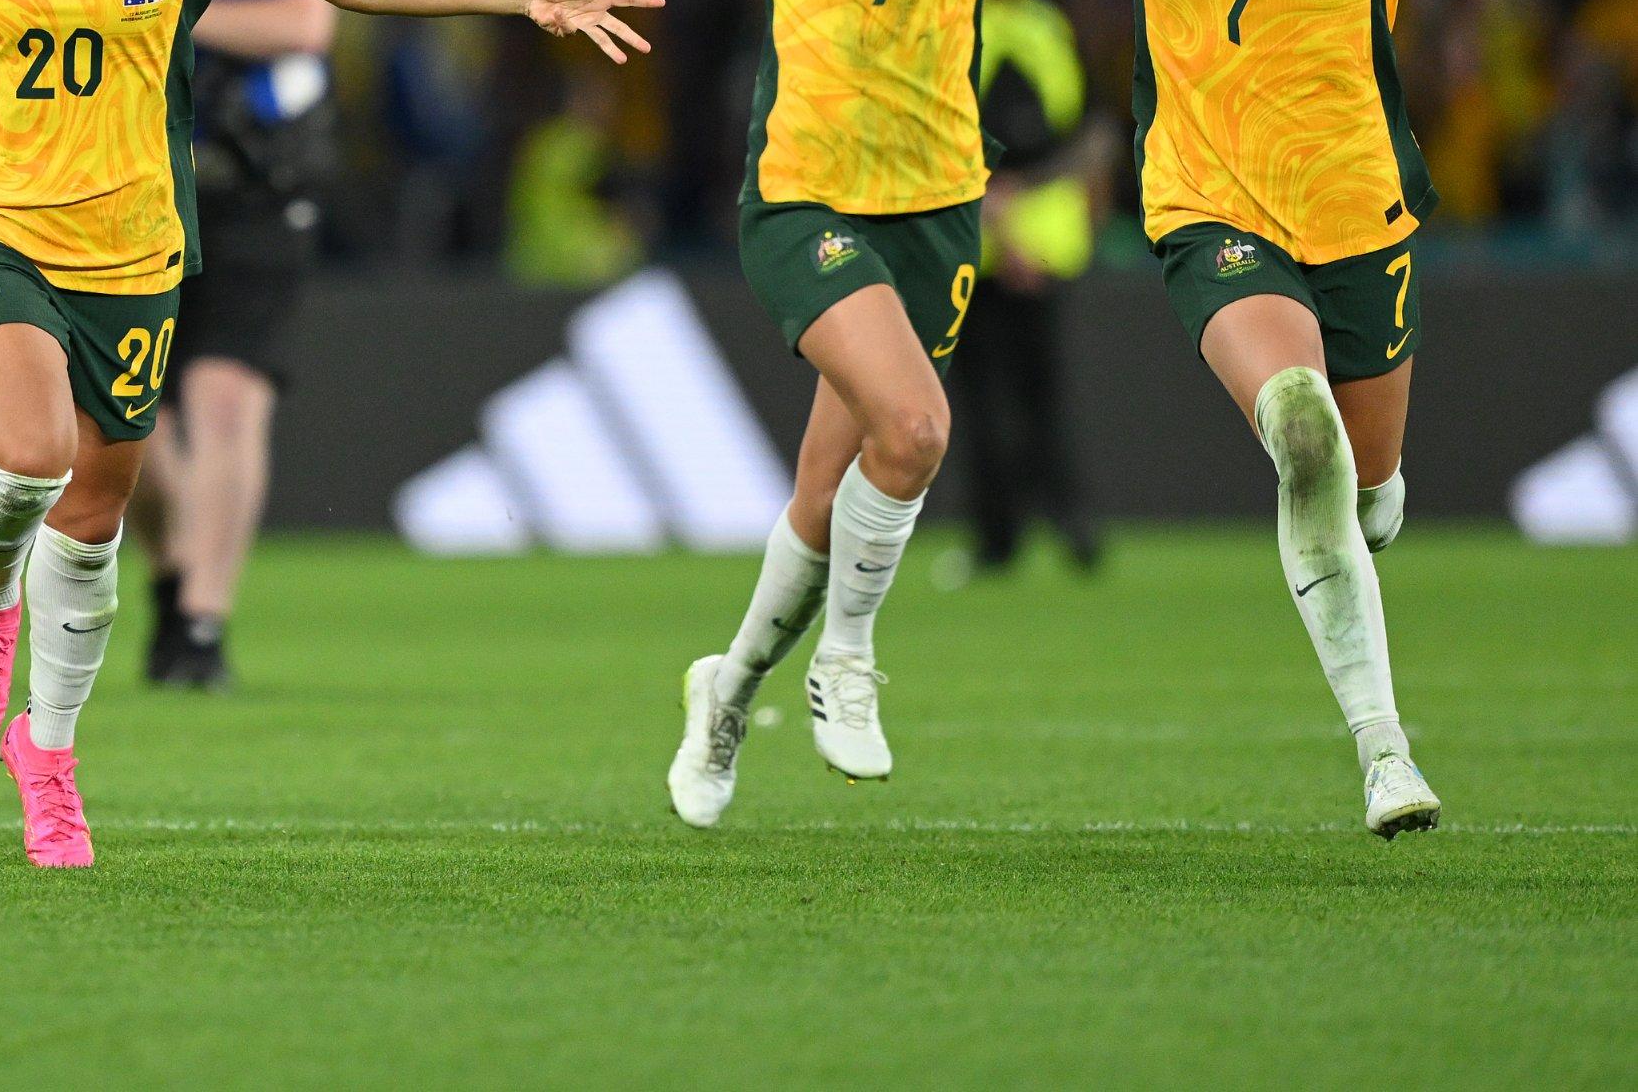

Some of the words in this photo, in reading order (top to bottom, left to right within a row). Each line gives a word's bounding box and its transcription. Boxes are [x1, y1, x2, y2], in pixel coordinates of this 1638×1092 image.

[15, 27, 104, 100] 20
[946, 263, 976, 338] 9
[1220, 259, 1256, 273] AUSTRALIA
[1385, 250, 1411, 329] 7
[111, 317, 175, 397] 20
